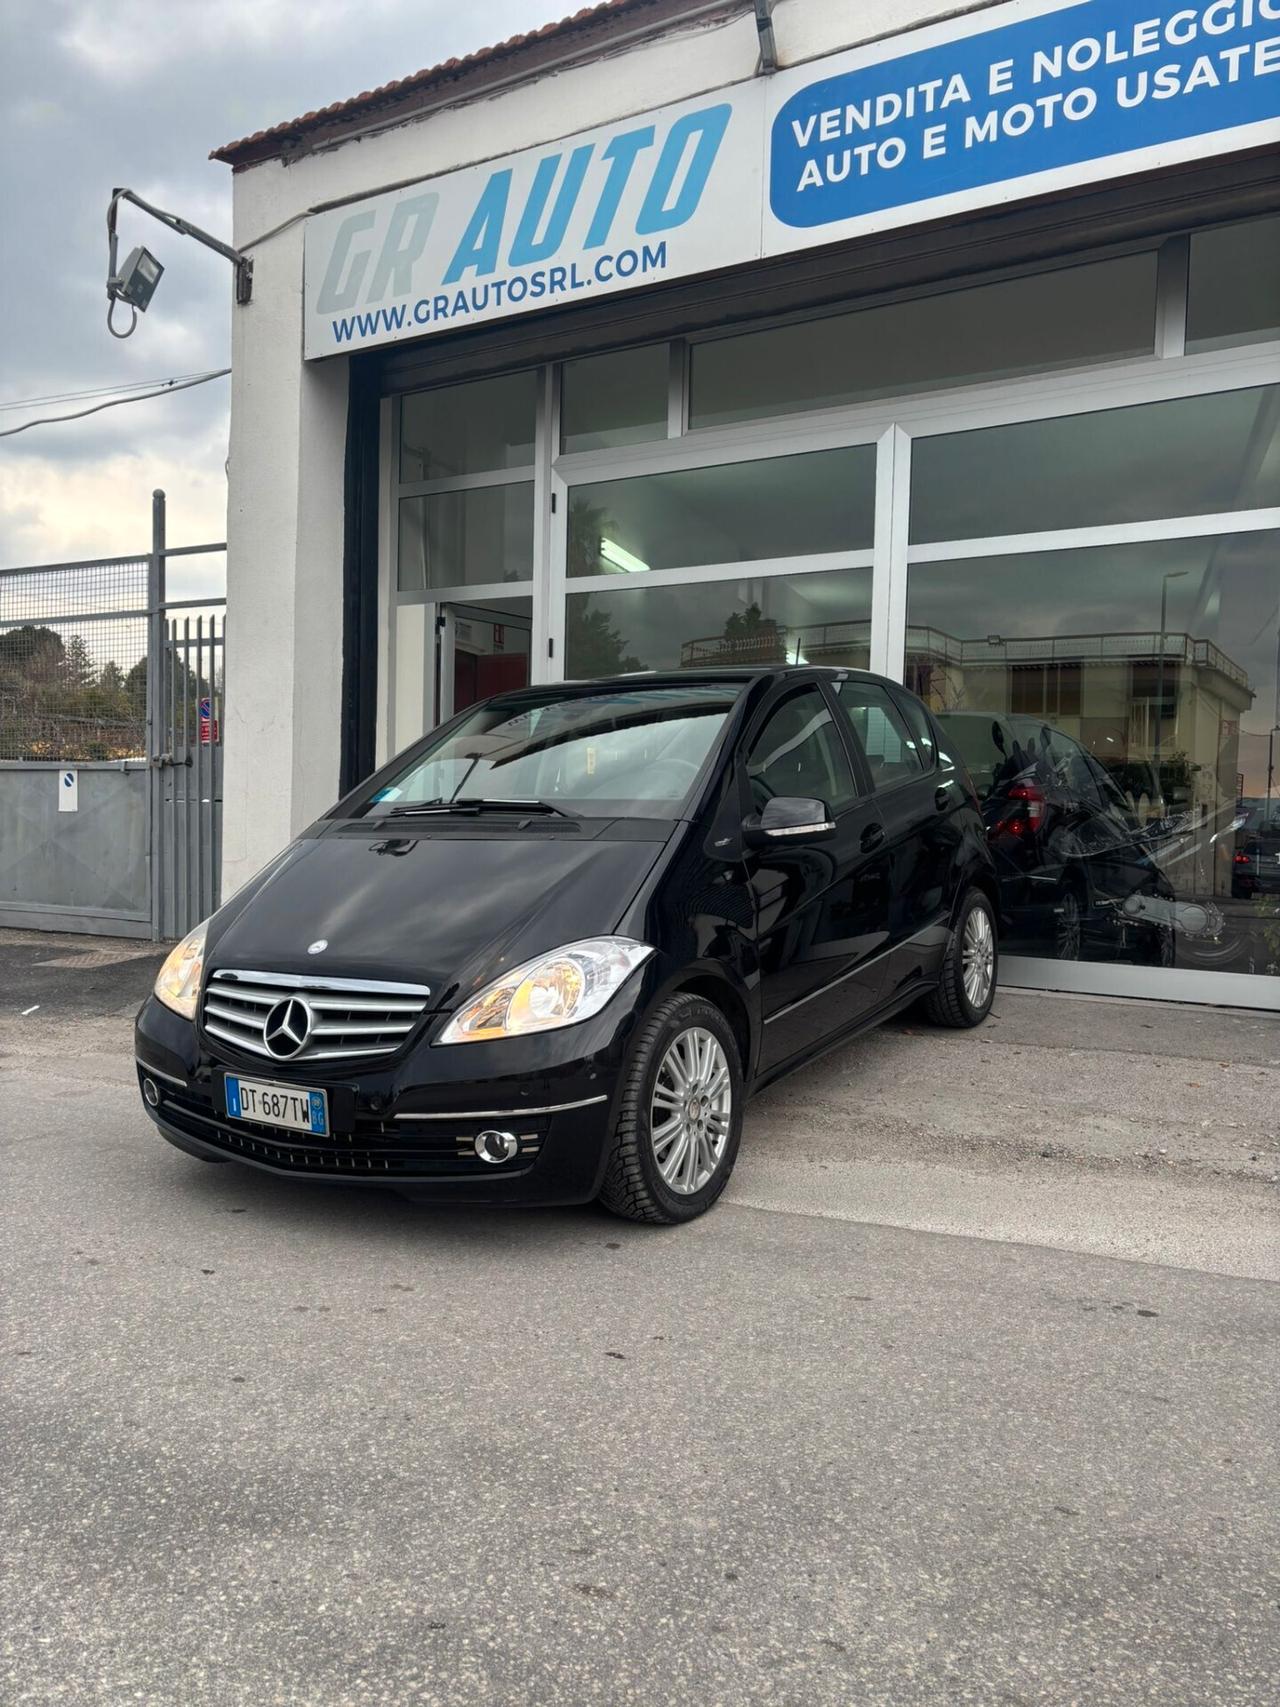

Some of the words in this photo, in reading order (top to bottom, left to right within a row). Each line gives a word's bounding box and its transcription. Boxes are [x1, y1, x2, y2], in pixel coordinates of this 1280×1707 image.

[791, 73, 971, 148] VENDITA
[989, 58, 1014, 96] E
[1032, 0, 1280, 84] NOLEGGI
[796, 137, 907, 193] AUTO
[923, 123, 947, 160] E
[965, 87, 1098, 149] MOTO
[1116, 36, 1280, 108] USATE
[316, 191, 440, 315] GR
[440, 103, 733, 287] AUTO
[332, 240, 668, 343] WWW.GRAUTOSRL.COM
[240, 1087, 257, 1113] DT
[261, 1092, 310, 1124] 687TW
